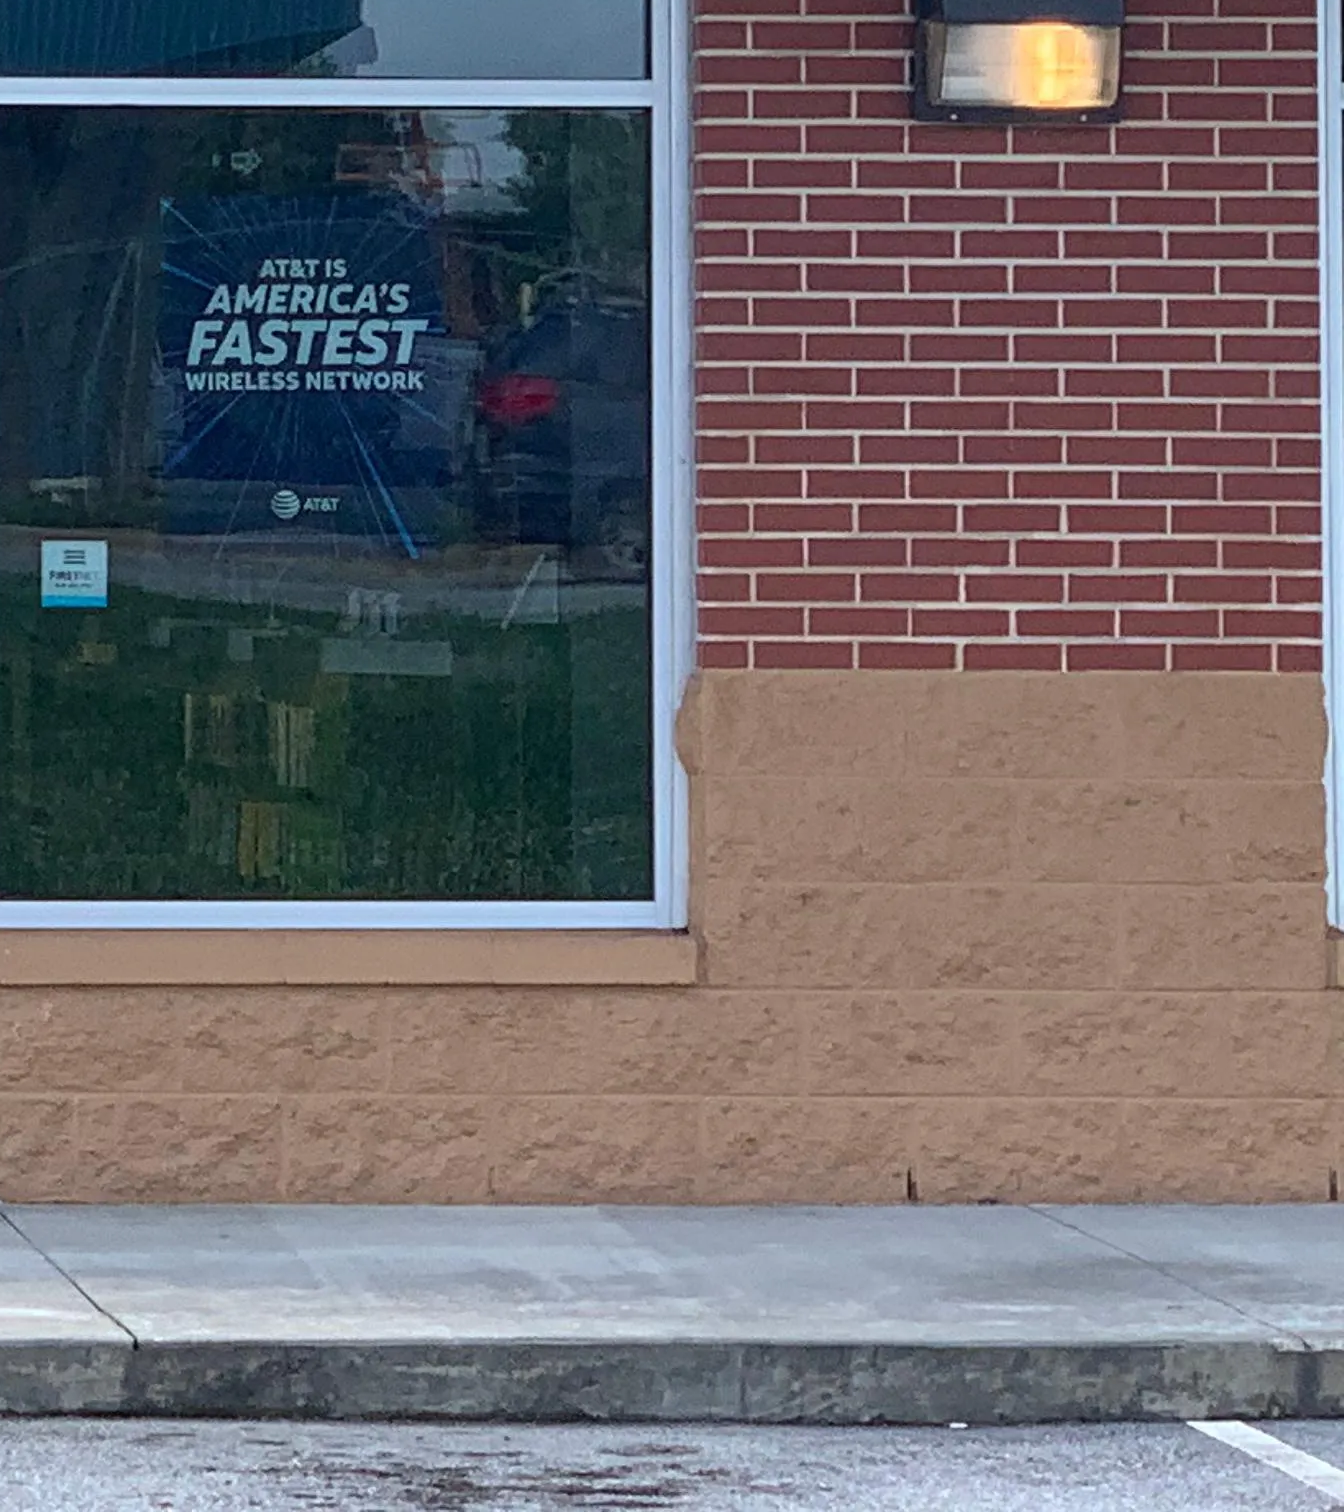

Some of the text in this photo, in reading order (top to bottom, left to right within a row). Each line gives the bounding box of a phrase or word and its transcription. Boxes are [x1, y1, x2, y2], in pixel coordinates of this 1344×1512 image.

[260, 259, 347, 278] AT&T IS
[203, 283, 411, 314] AMERICA'S
[186, 319, 429, 366] FASTEST
[185, 371, 424, 392] WIRELESS NETWORK
[303, 497, 340, 512] AT&T
